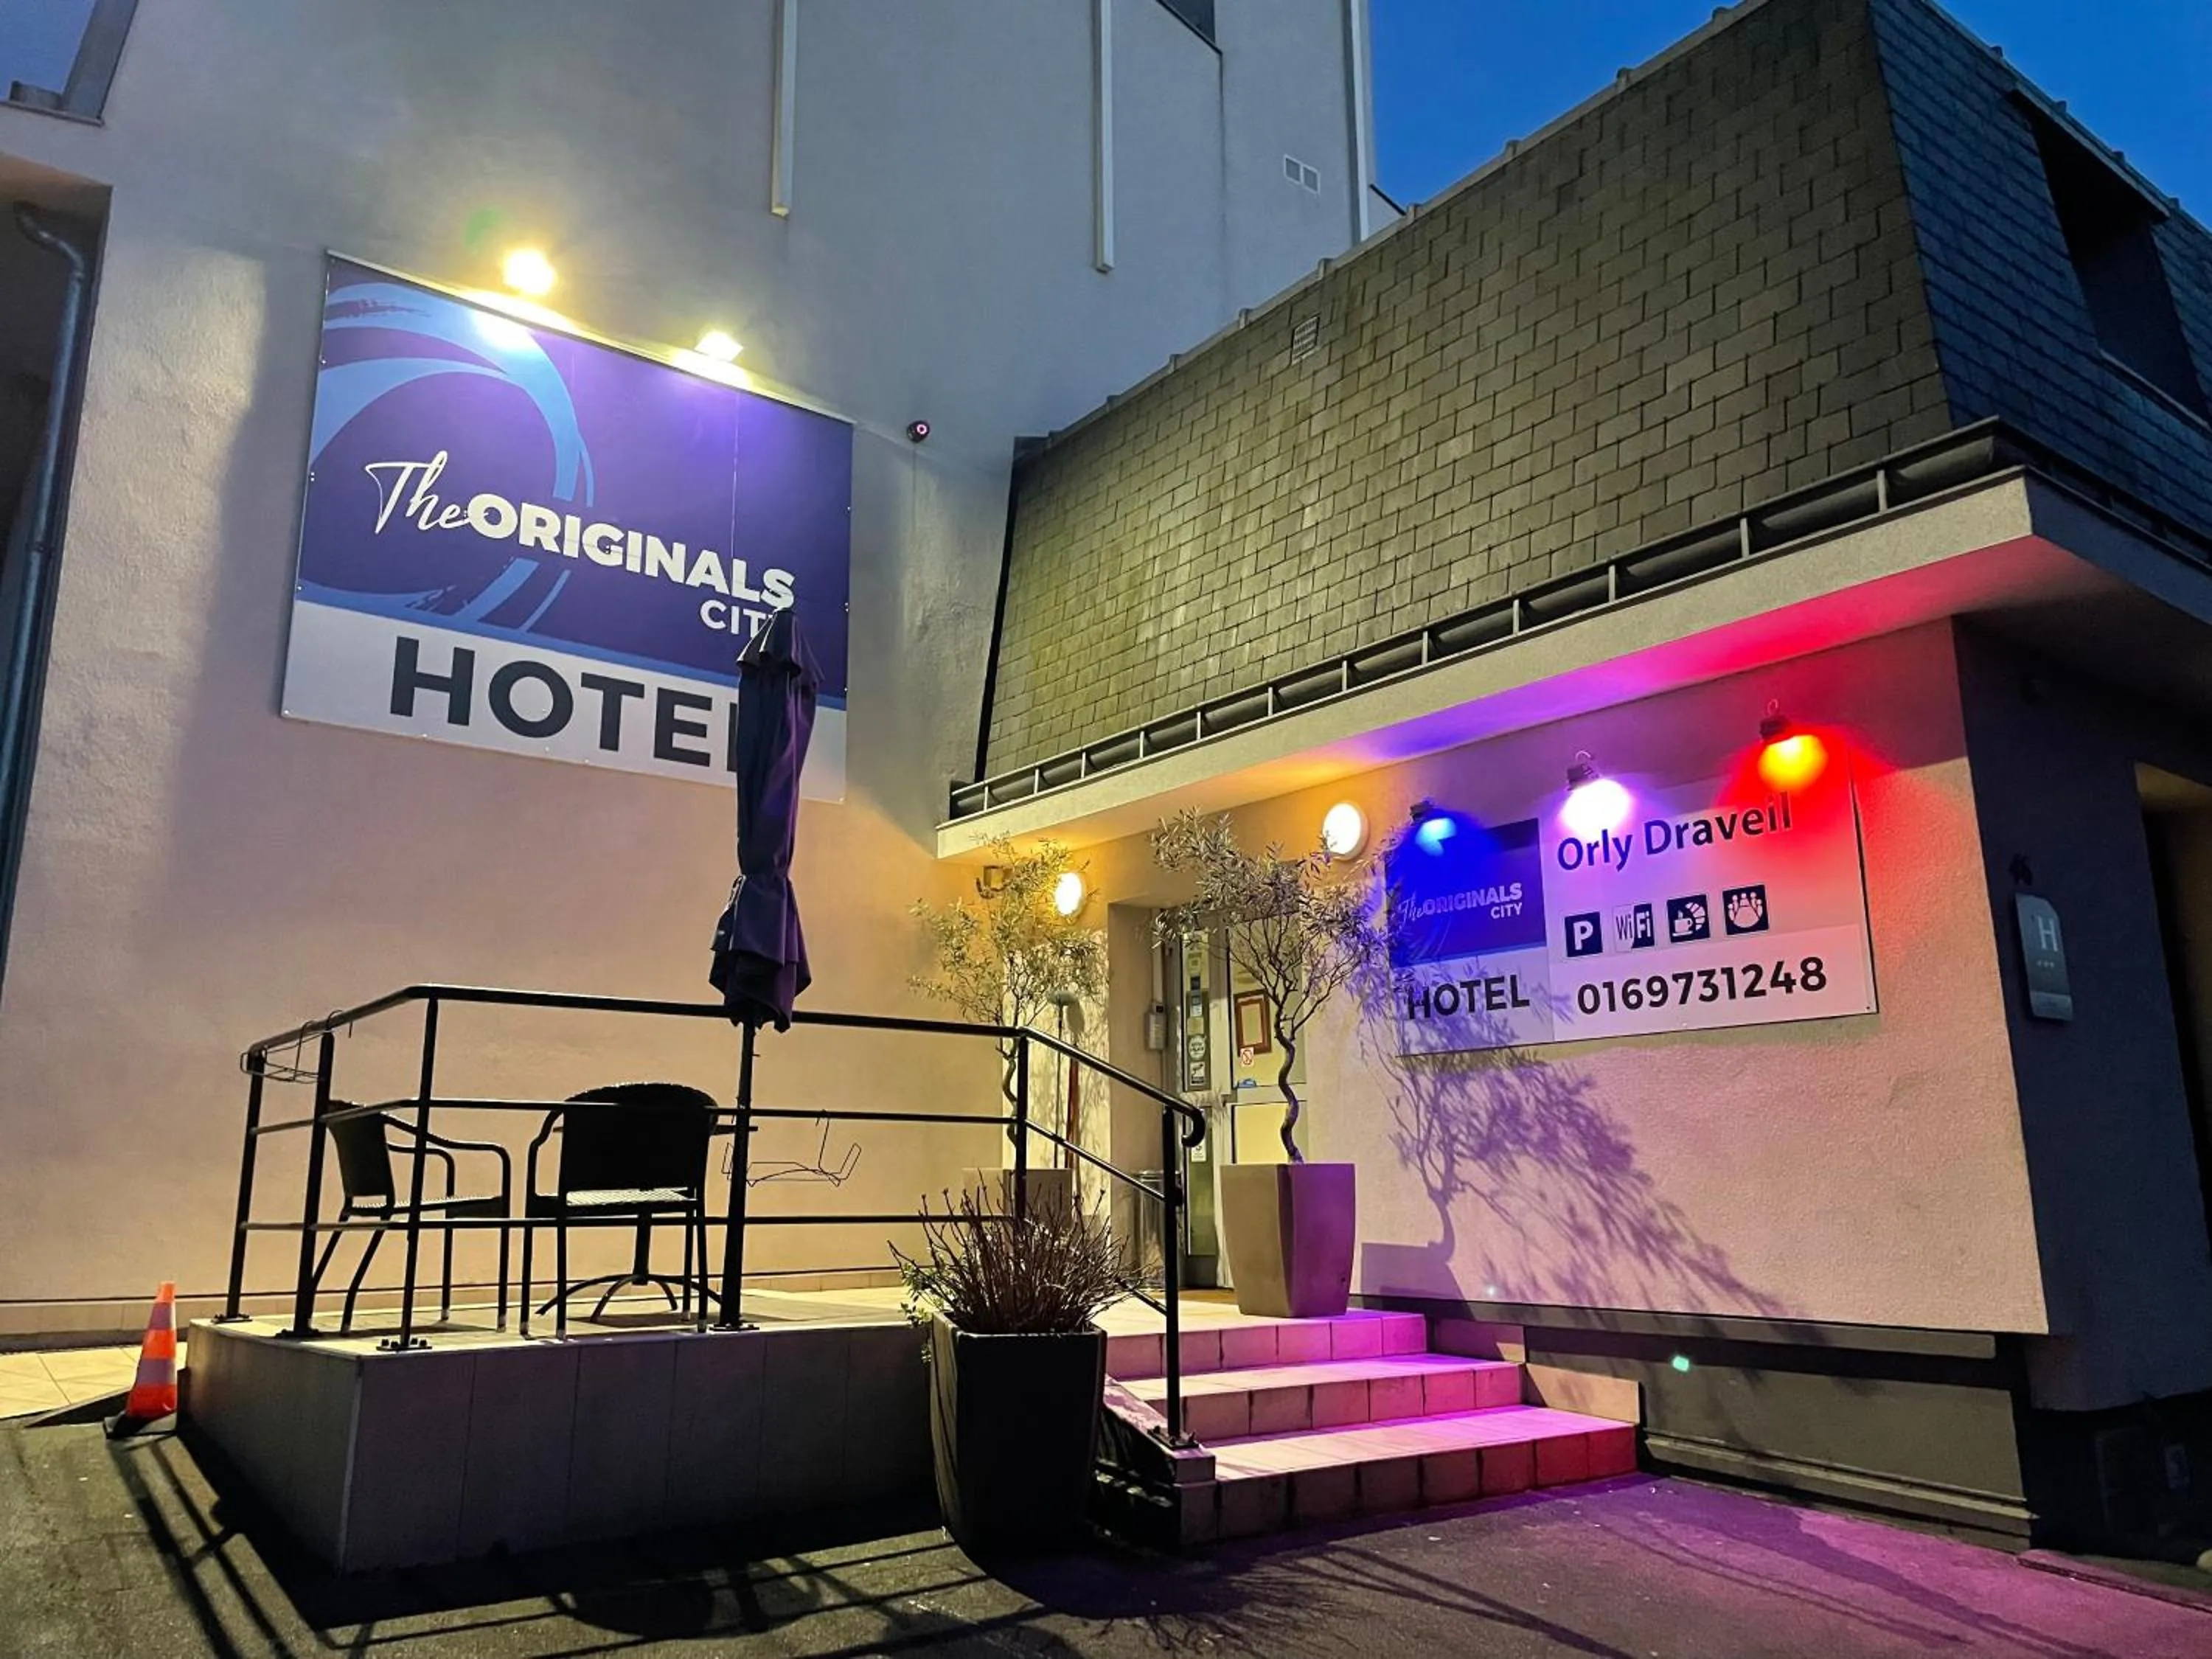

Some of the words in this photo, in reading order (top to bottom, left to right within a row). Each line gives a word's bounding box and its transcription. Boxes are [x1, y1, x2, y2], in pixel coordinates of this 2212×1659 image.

[365, 450, 470, 535] The
[467, 493, 795, 610] ORIGINALS
[700, 599, 774, 639] CIT
[390, 636, 737, 773] HOTE
[1557, 829, 1632, 872] Orly
[1644, 791, 1791, 855] Draveil
[1422, 883, 1523, 915] ORIGINALS
[1490, 902, 1523, 919] CITY
[2037, 916, 2059, 952] H
[1408, 974, 1530, 1020] HOTEL
[1576, 956, 1827, 1015] 0169731248
